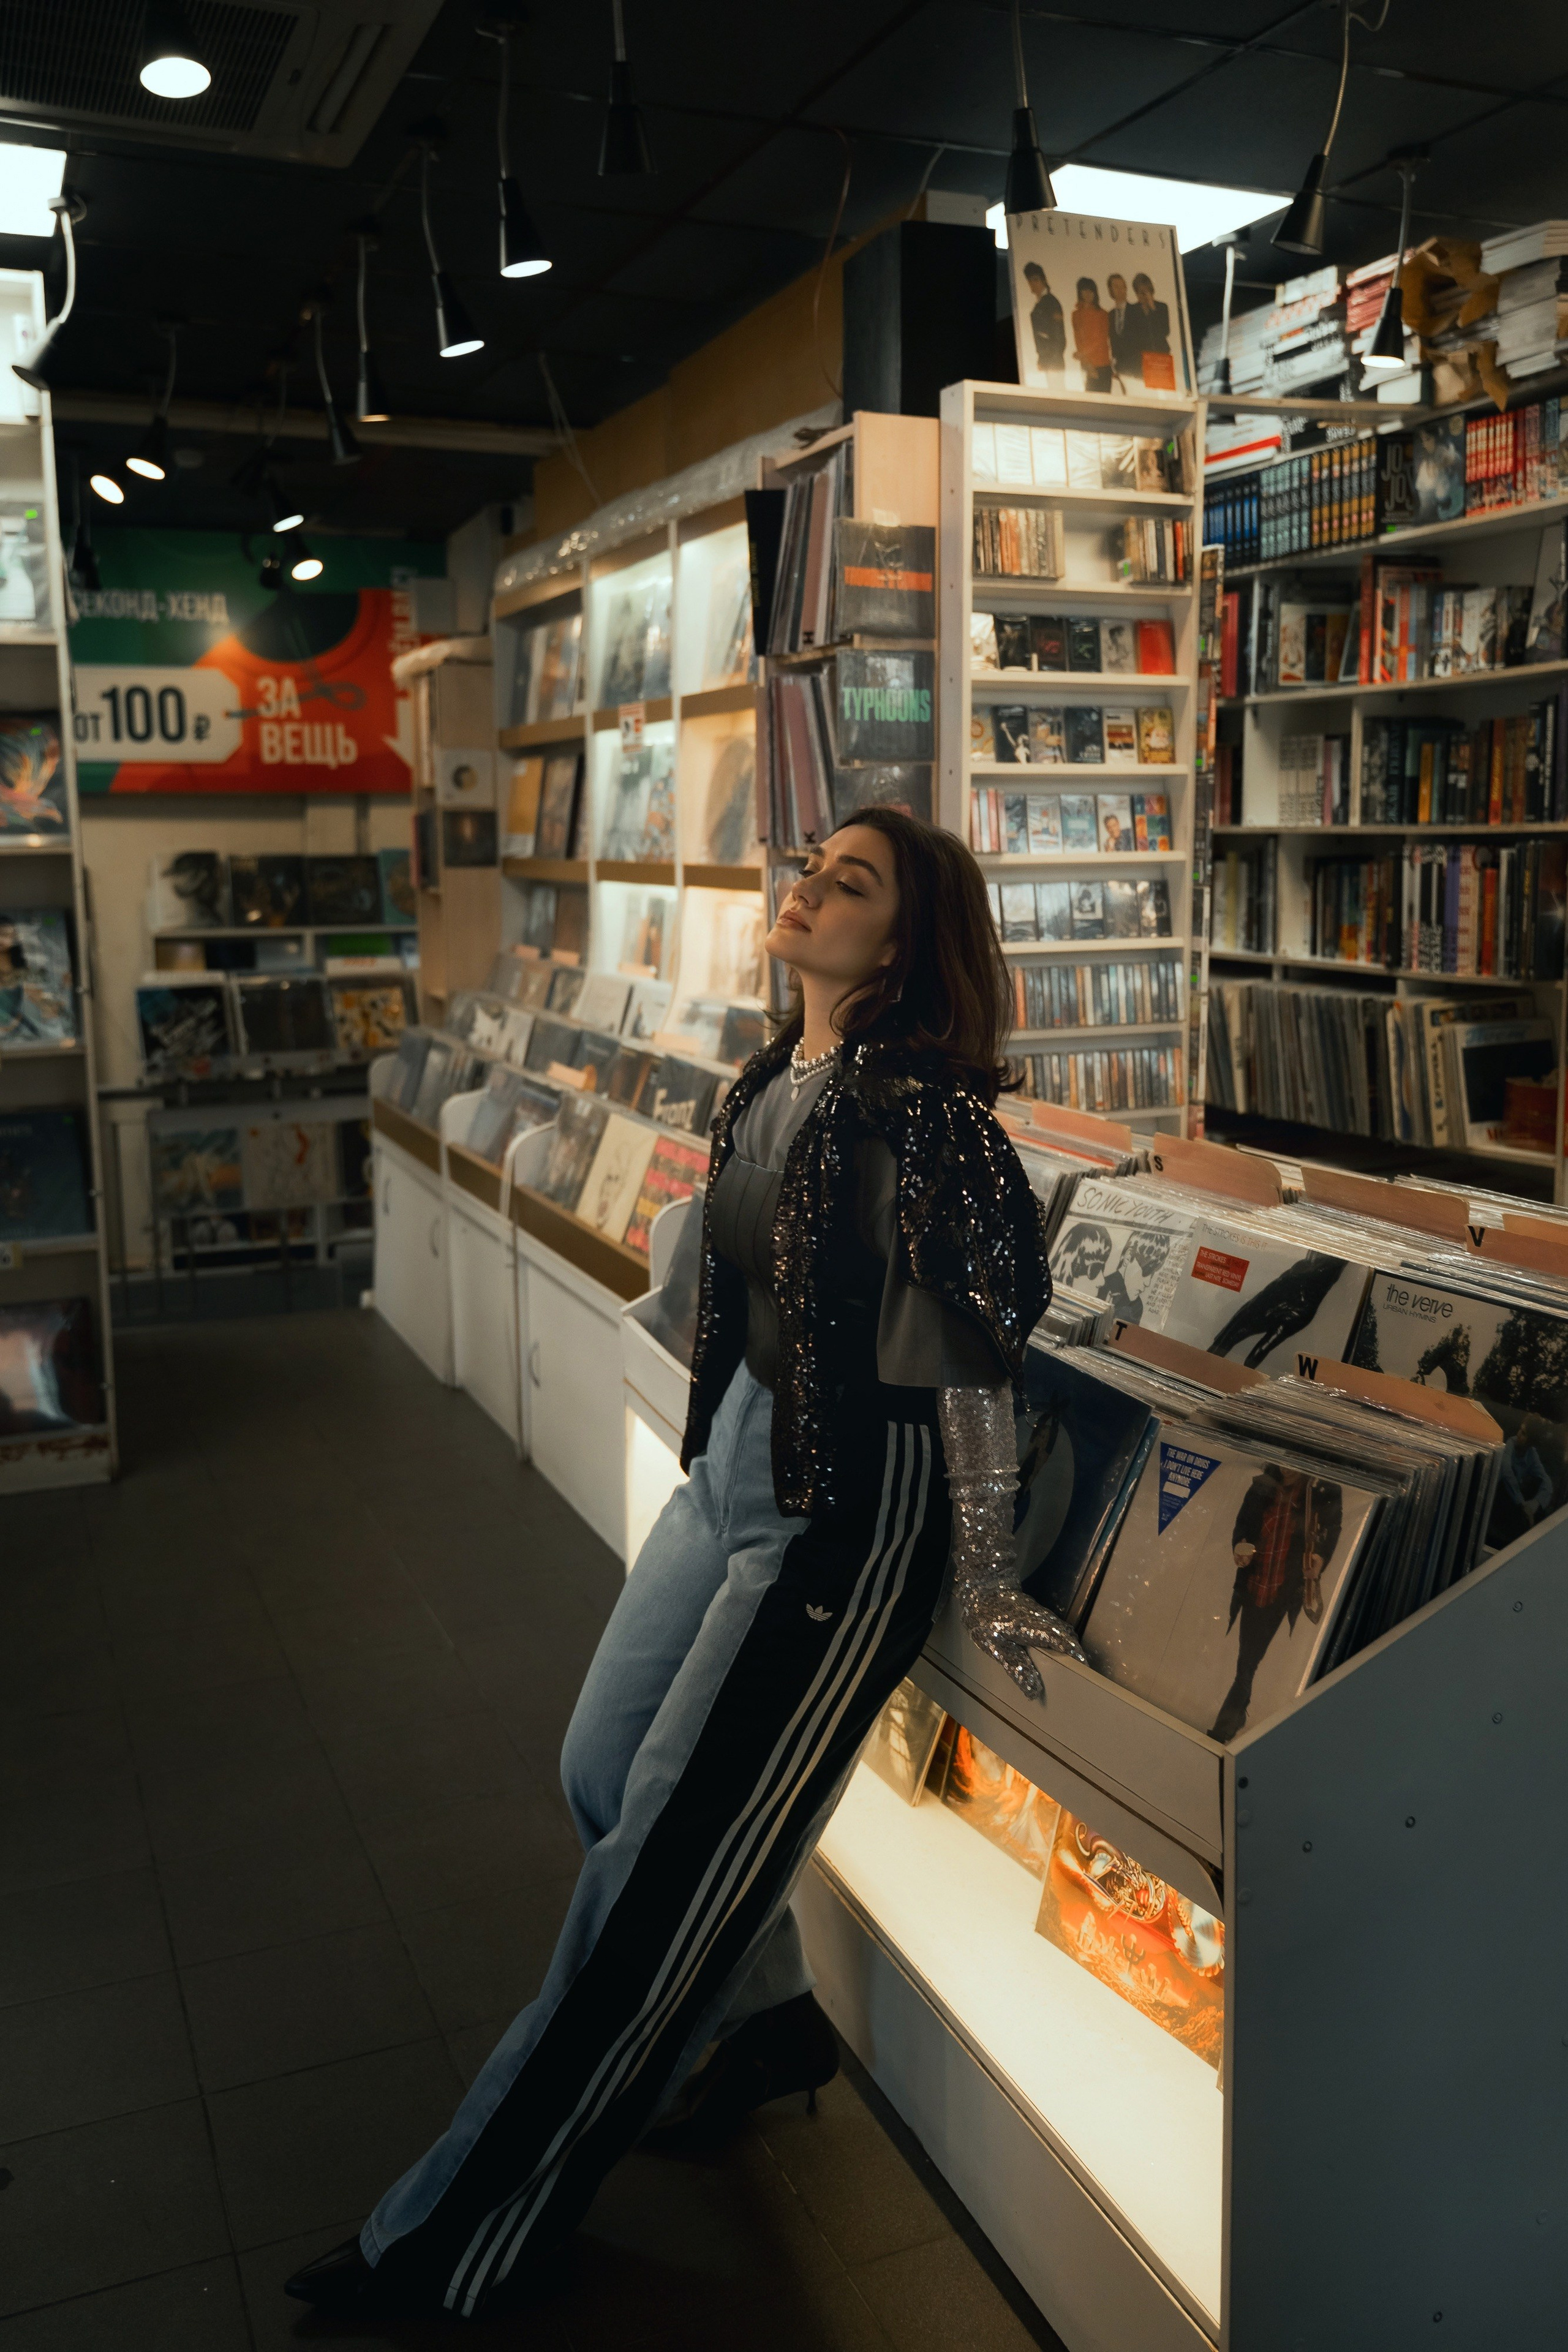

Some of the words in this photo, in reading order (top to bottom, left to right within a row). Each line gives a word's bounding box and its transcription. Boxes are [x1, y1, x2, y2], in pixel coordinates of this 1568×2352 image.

[256, 676, 301, 720] ЗА
[842, 687, 931, 723] TYPHOONS
[100, 684, 187, 745] 100
[258, 722, 358, 771] ВЕЩЬ
[1153, 1155, 1164, 1172] S
[1077, 1186, 1128, 1214] SONIC
[1125, 1200, 1175, 1224] YOUTH
[1213, 1227, 1240, 1243] STROKES
[1467, 1225, 1485, 1248] V
[1383, 1303, 1408, 1315] URBAN
[1409, 1311, 1437, 1323] HYMNS
[1387, 1284, 1409, 1306] the
[1412, 1294, 1453, 1318] verve
[1115, 1321, 1128, 1341] T
[1298, 1354, 1319, 1380] W
